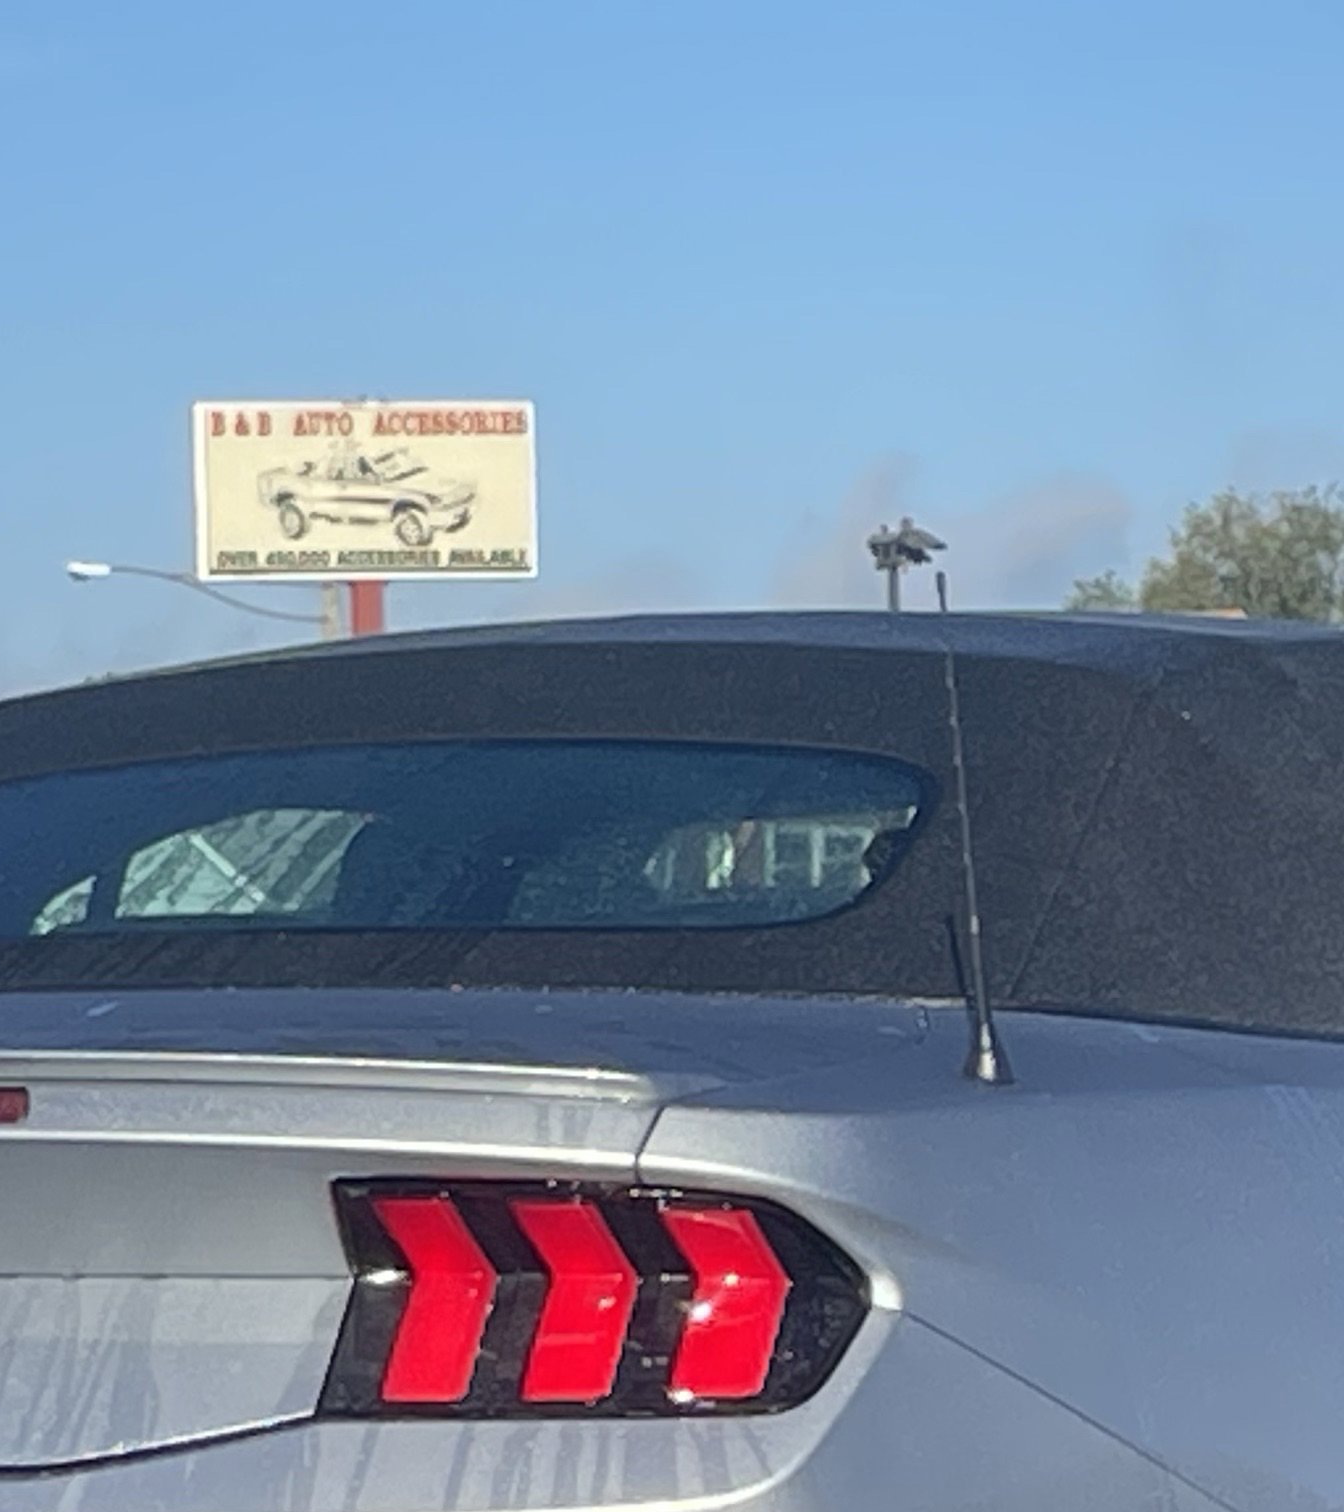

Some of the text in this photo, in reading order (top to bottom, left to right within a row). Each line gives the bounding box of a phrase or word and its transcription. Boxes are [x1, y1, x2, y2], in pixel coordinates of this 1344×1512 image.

[211, 411, 529, 436] B & B AUTO ACCESSORIES
[217, 550, 258, 568] OVER
[337, 550, 440, 567] ACCESSORIES
[447, 549, 529, 567] AVAILABLE
